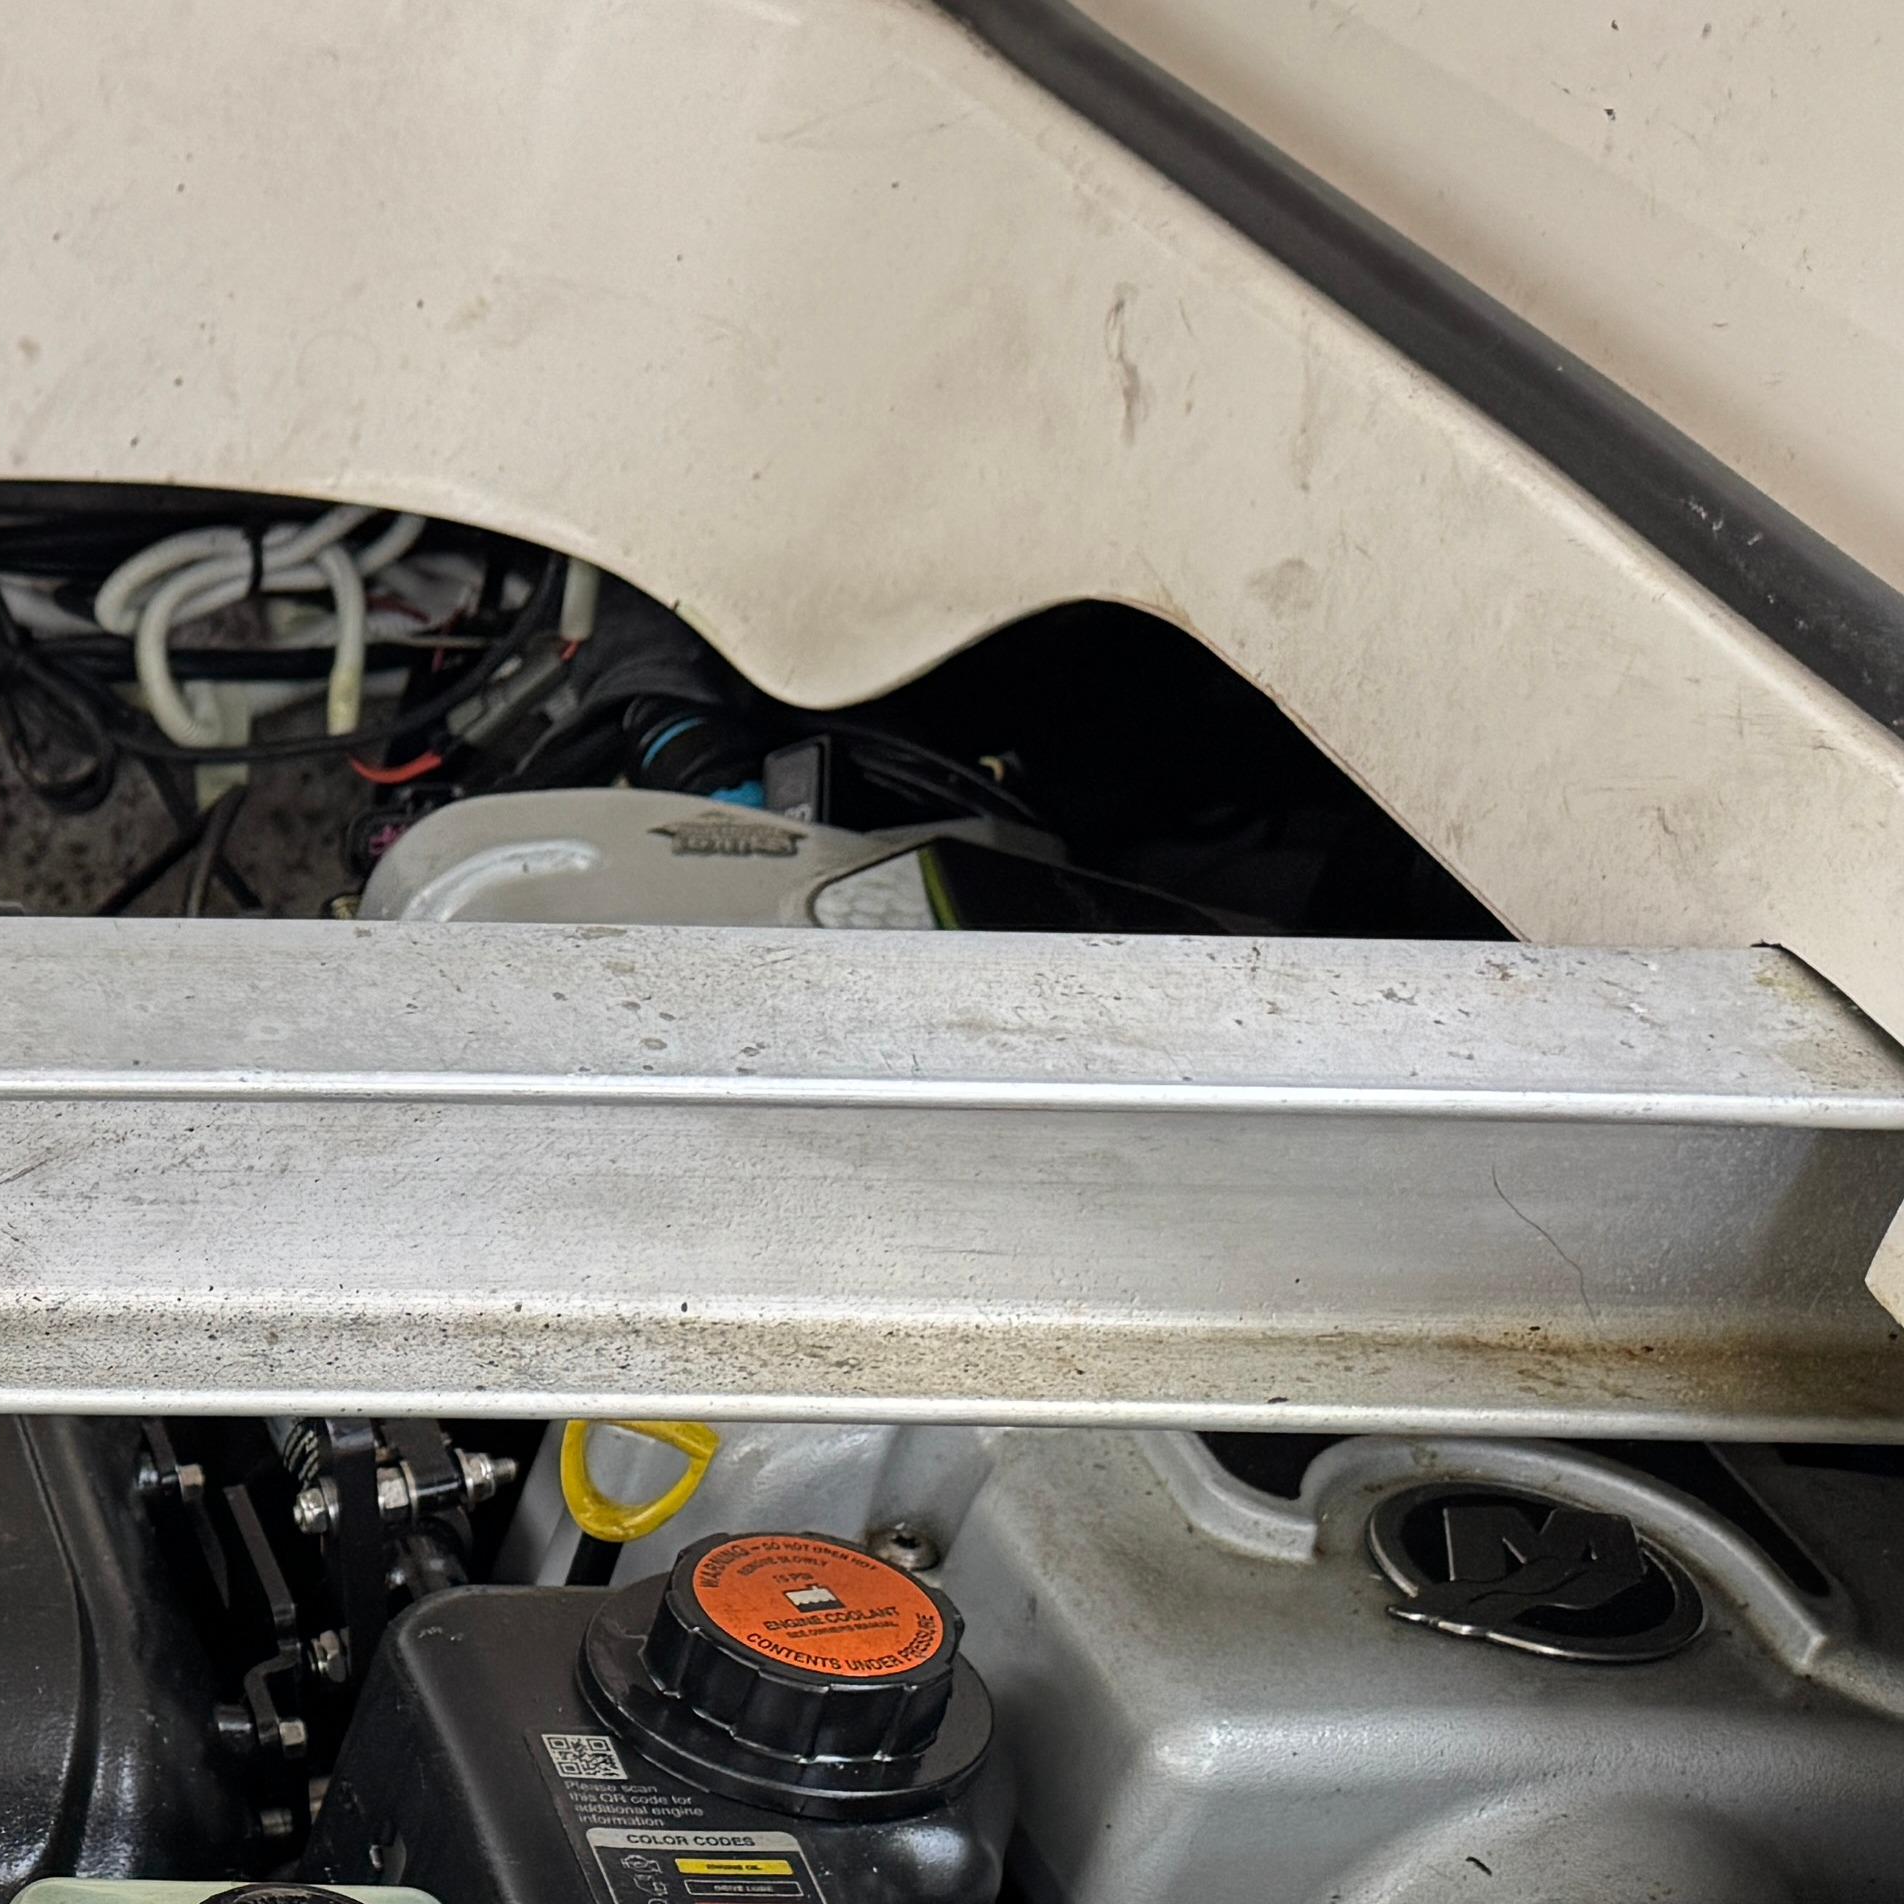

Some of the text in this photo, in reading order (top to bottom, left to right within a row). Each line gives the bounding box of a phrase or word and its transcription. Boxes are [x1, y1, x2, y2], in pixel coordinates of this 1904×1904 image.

[700, 1543, 751, 1589] WARNING
[824, 1606, 901, 1624] COOLANT
[746, 1632, 842, 1670] CONTENTS
[845, 1656, 903, 1672] UNDER
[564, 1779, 658, 1793] Please scan
[599, 1792, 627, 1803] QR
[630, 1795, 668, 1805] code
[671, 1795, 693, 1806] for
[574, 1803, 705, 1819] additional engine
[578, 1813, 666, 1827] information
[626, 1833, 756, 1848] COLOR CODES
